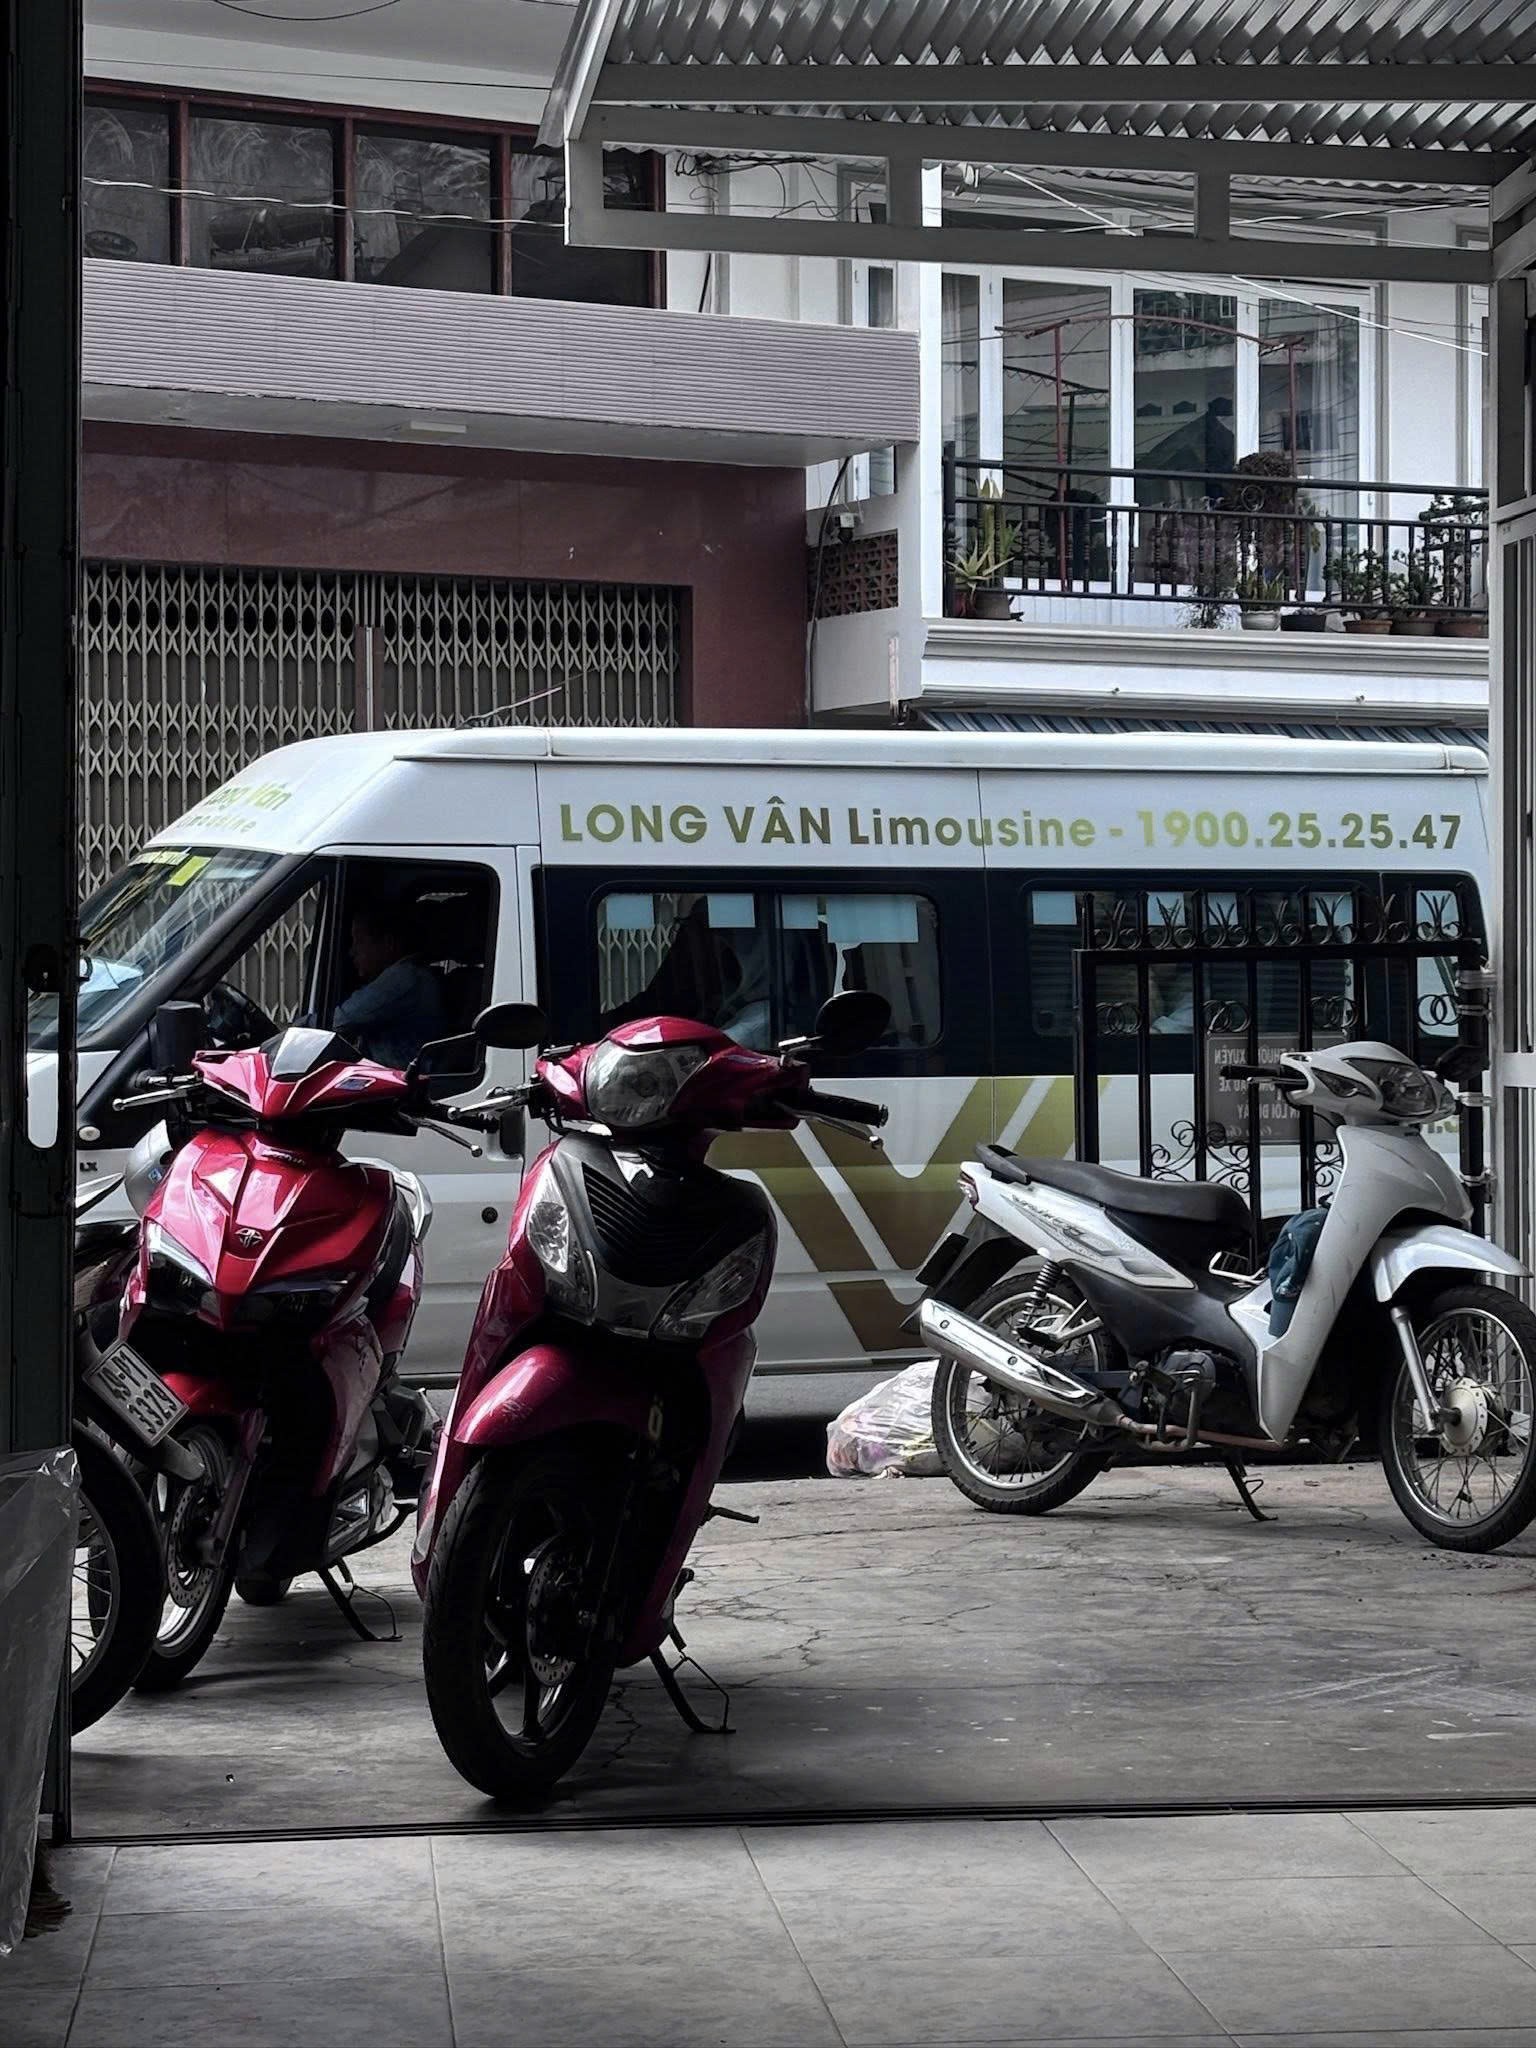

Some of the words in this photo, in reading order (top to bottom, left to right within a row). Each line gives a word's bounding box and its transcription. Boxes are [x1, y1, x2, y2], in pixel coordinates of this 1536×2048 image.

[561, 804, 707, 843] LONG
[723, 796, 830, 844] VÂN
[848, 807, 1095, 848] Limousine
[1136, 810, 1461, 849] 1900.25.25.47
[128, 1382, 177, 1434] 3329
